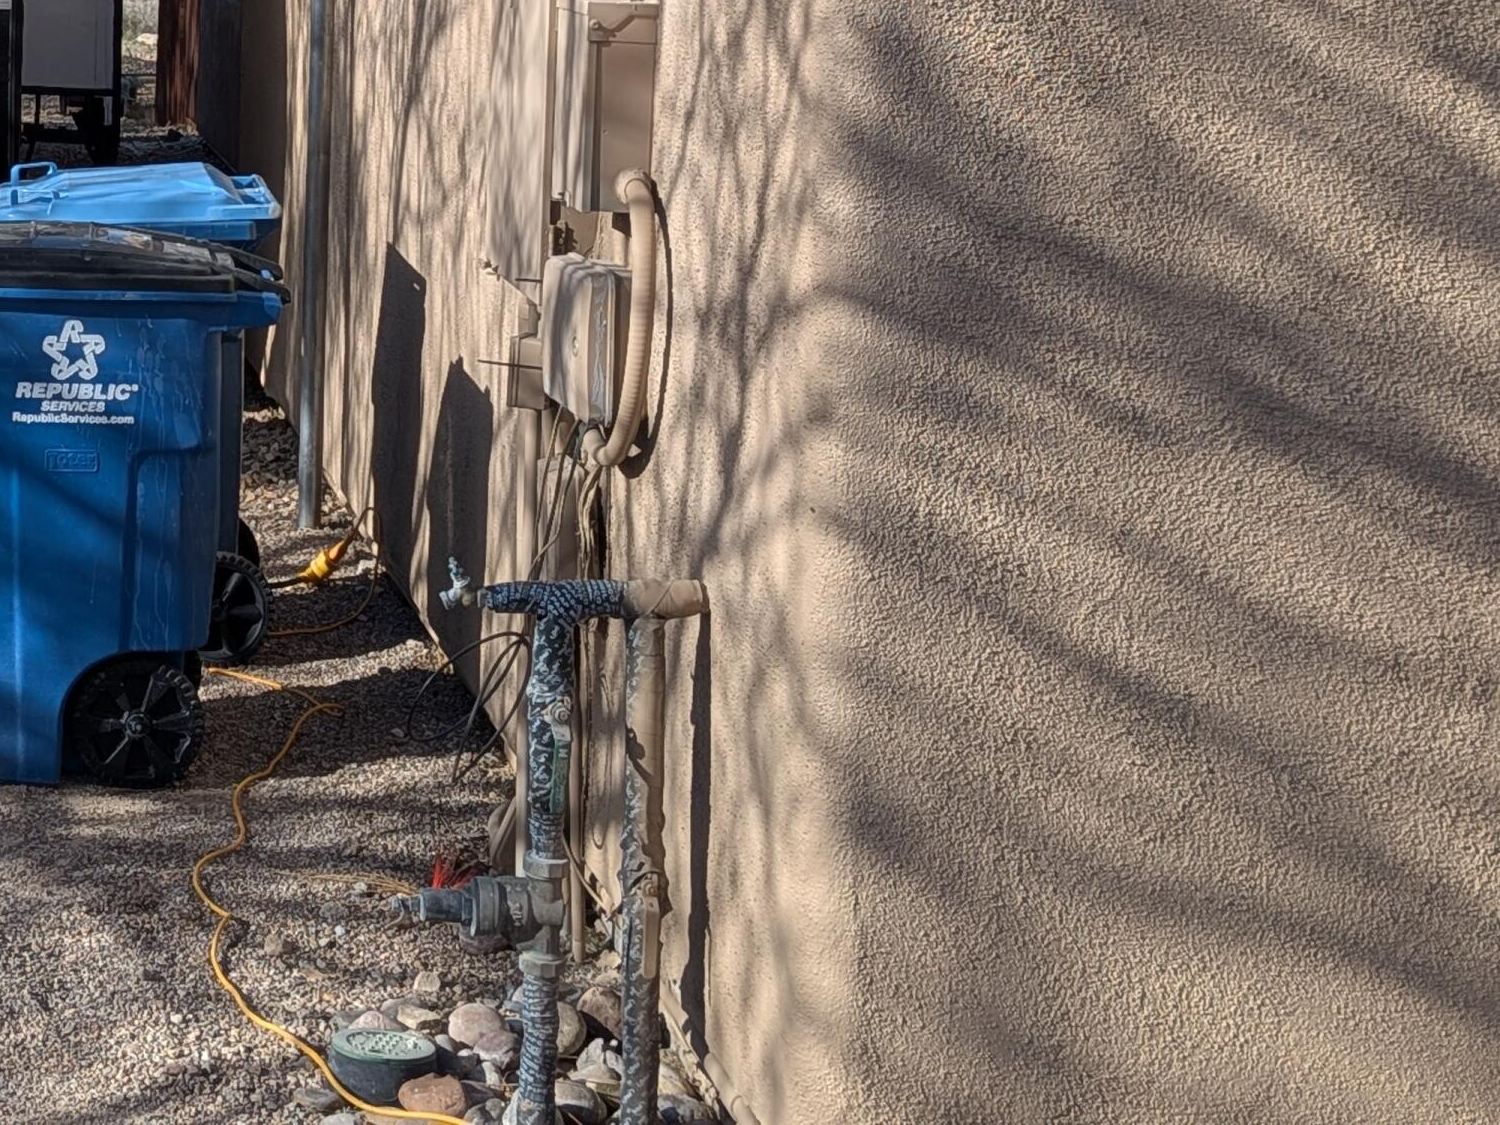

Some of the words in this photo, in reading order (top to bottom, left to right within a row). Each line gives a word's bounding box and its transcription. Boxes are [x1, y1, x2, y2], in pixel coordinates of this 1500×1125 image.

[15, 382, 133, 400] REPUBLIC
[41, 400, 105, 412] SERVICES
[12, 412, 134, 424] RepublicServices.com
